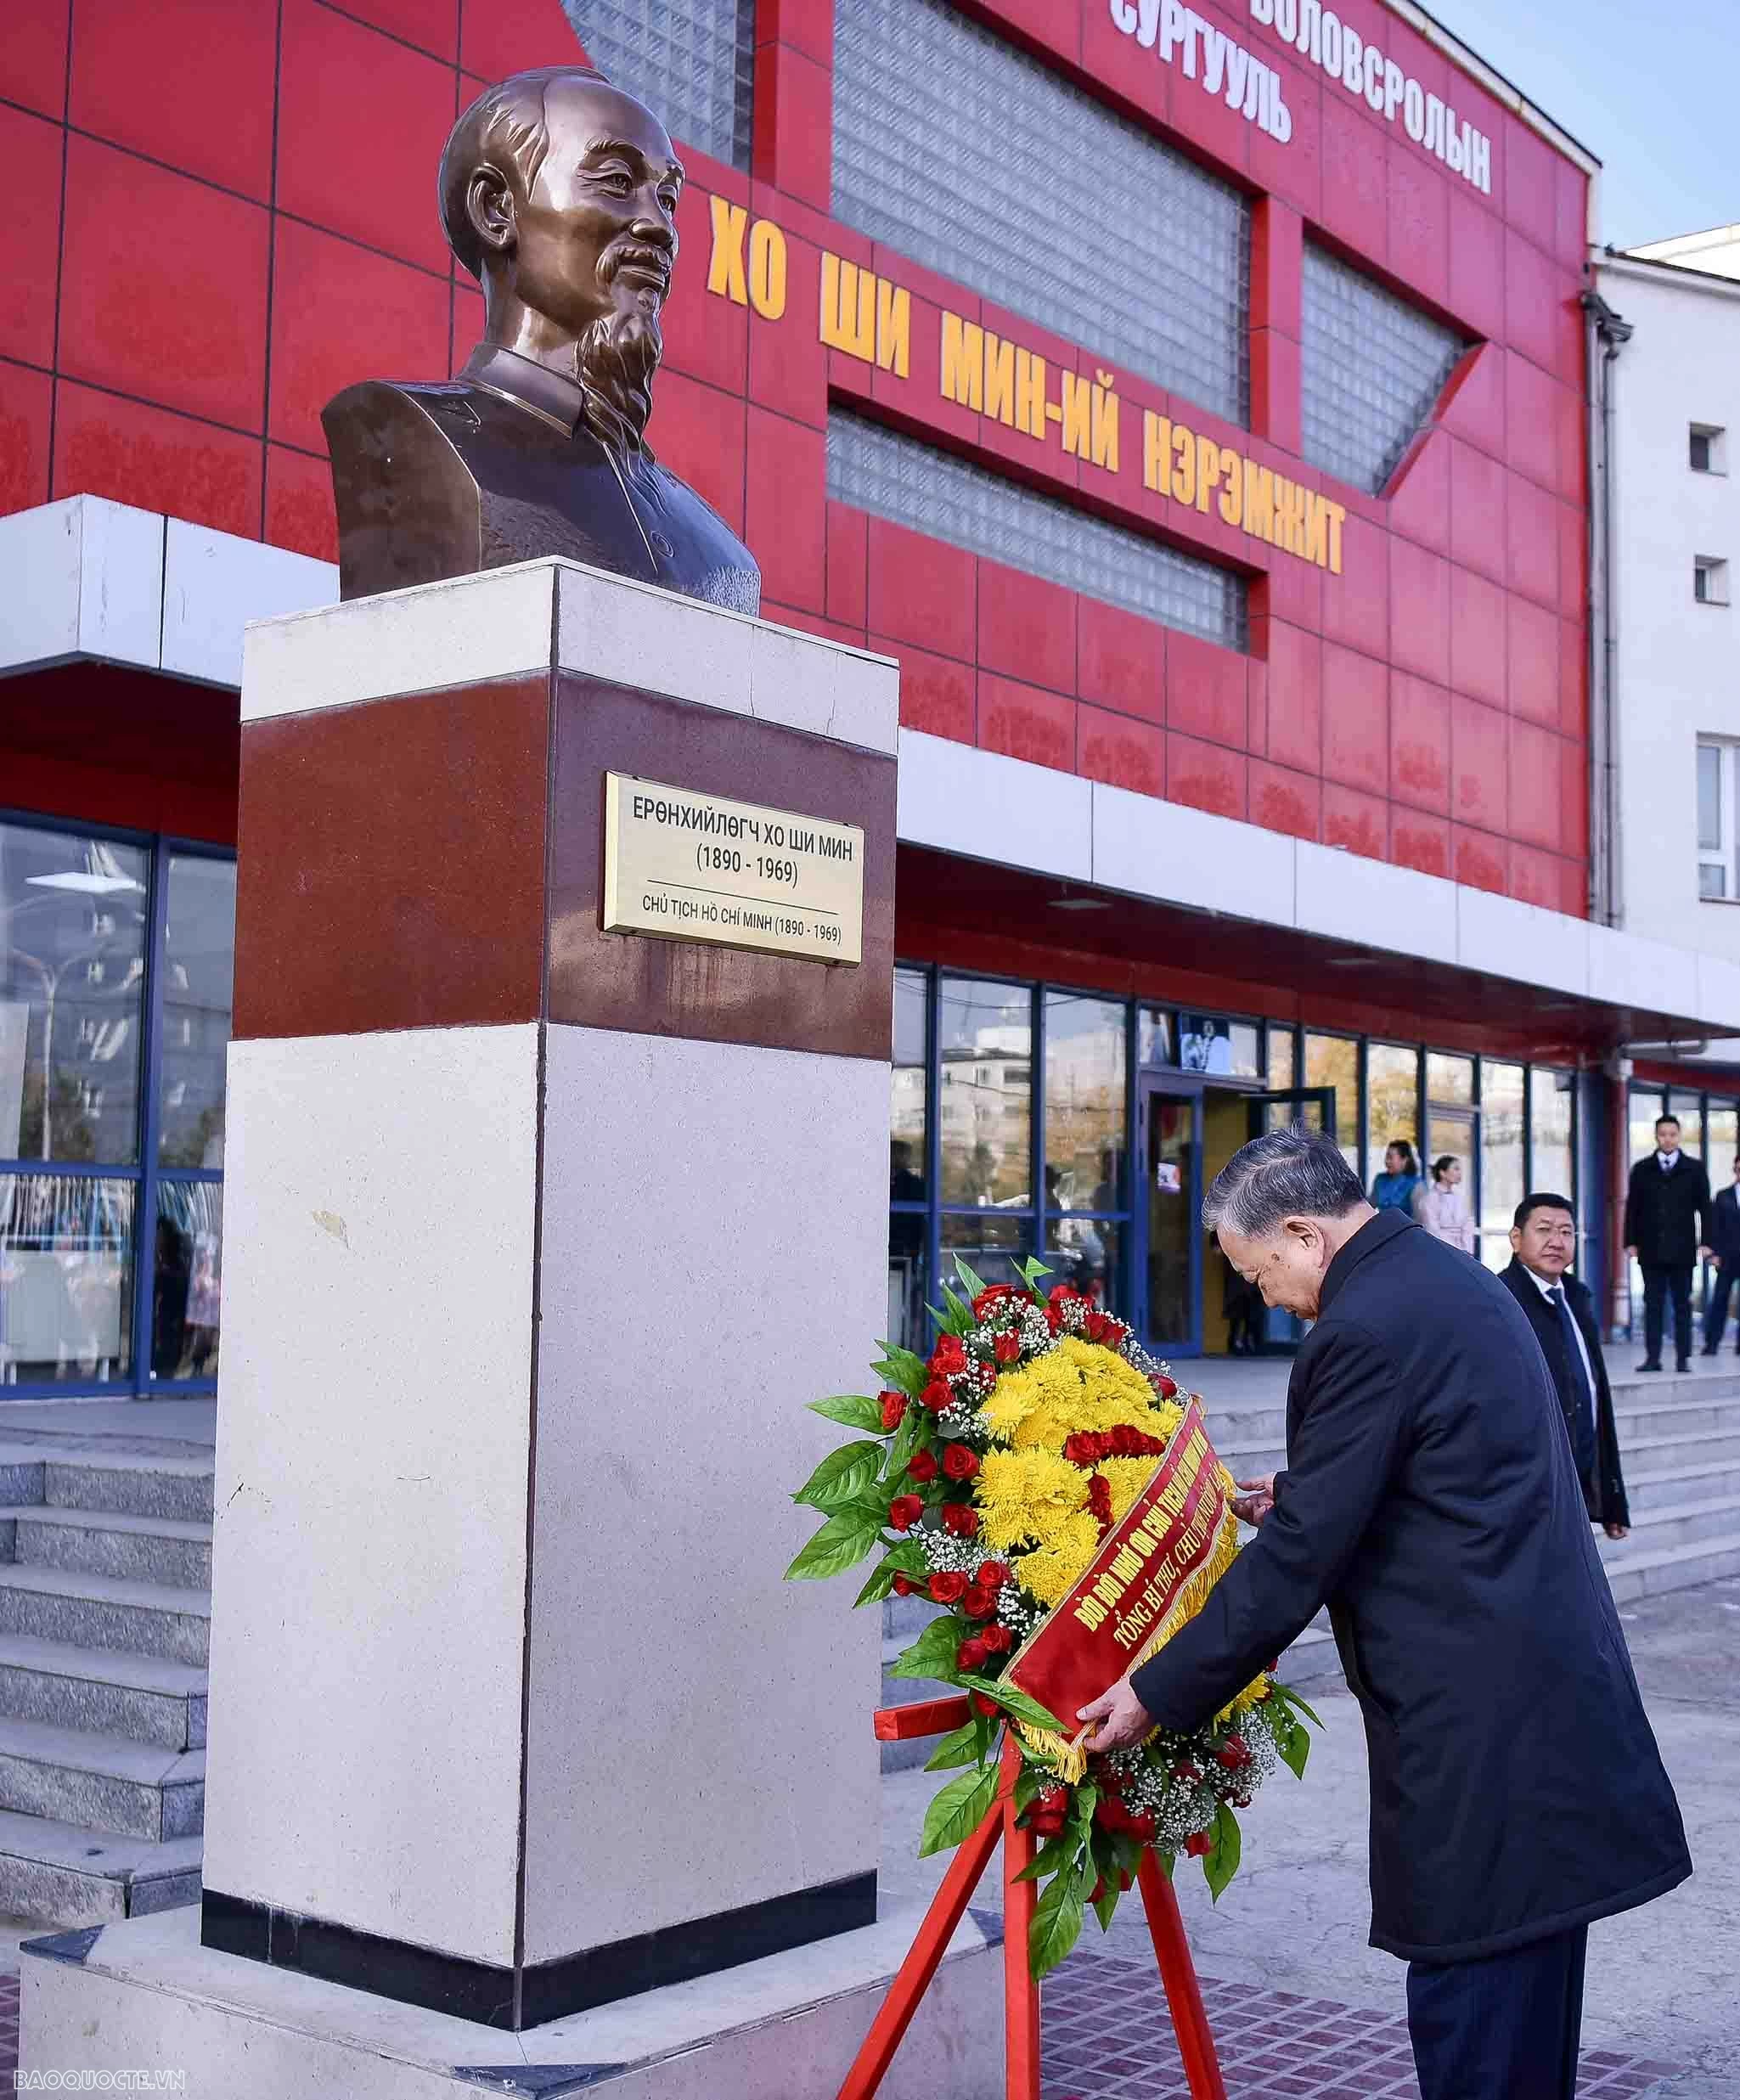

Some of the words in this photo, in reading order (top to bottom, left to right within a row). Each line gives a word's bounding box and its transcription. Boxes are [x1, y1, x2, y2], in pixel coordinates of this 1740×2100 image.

[707, 194, 787, 320] ХО
[819, 251, 911, 379] ШИ
[940, 310, 1119, 473] МИН-ИЙ
[1143, 409, 1346, 575] НЭРЭМЖИТ
[633, 796, 760, 842] ЕРӨНХИЙЛӨГЧ
[764, 824, 784, 847] ХО
[789, 830, 814, 853] ШИ
[819, 835, 853, 862] МИН
[696, 843, 741, 872] (1890
[757, 857, 797, 888] 1969)
[642, 889, 667, 914] CHỦ
[671, 898, 698, 920] TỊCH
[701, 900, 718, 921] HỒ
[721, 905, 740, 926] CHÍ
[743, 911, 772, 932] MINH
[774, 917, 804, 937] (1890
[814, 924, 842, 946] 1969)
[1073, 1595, 1109, 1632] ĐỜI
[1092, 1572, 1126, 1608] ĐỜI
[1109, 1542, 1144, 1585] NHỚ
[1142, 1499, 1173, 1540] CHỦ
[1113, 1601, 1154, 1650] TỔNG
[1142, 1579, 1164, 1613] BÍ
[1154, 1553, 1181, 1594] THƯ,
[1175, 1522, 1201, 1566] CHỦ
